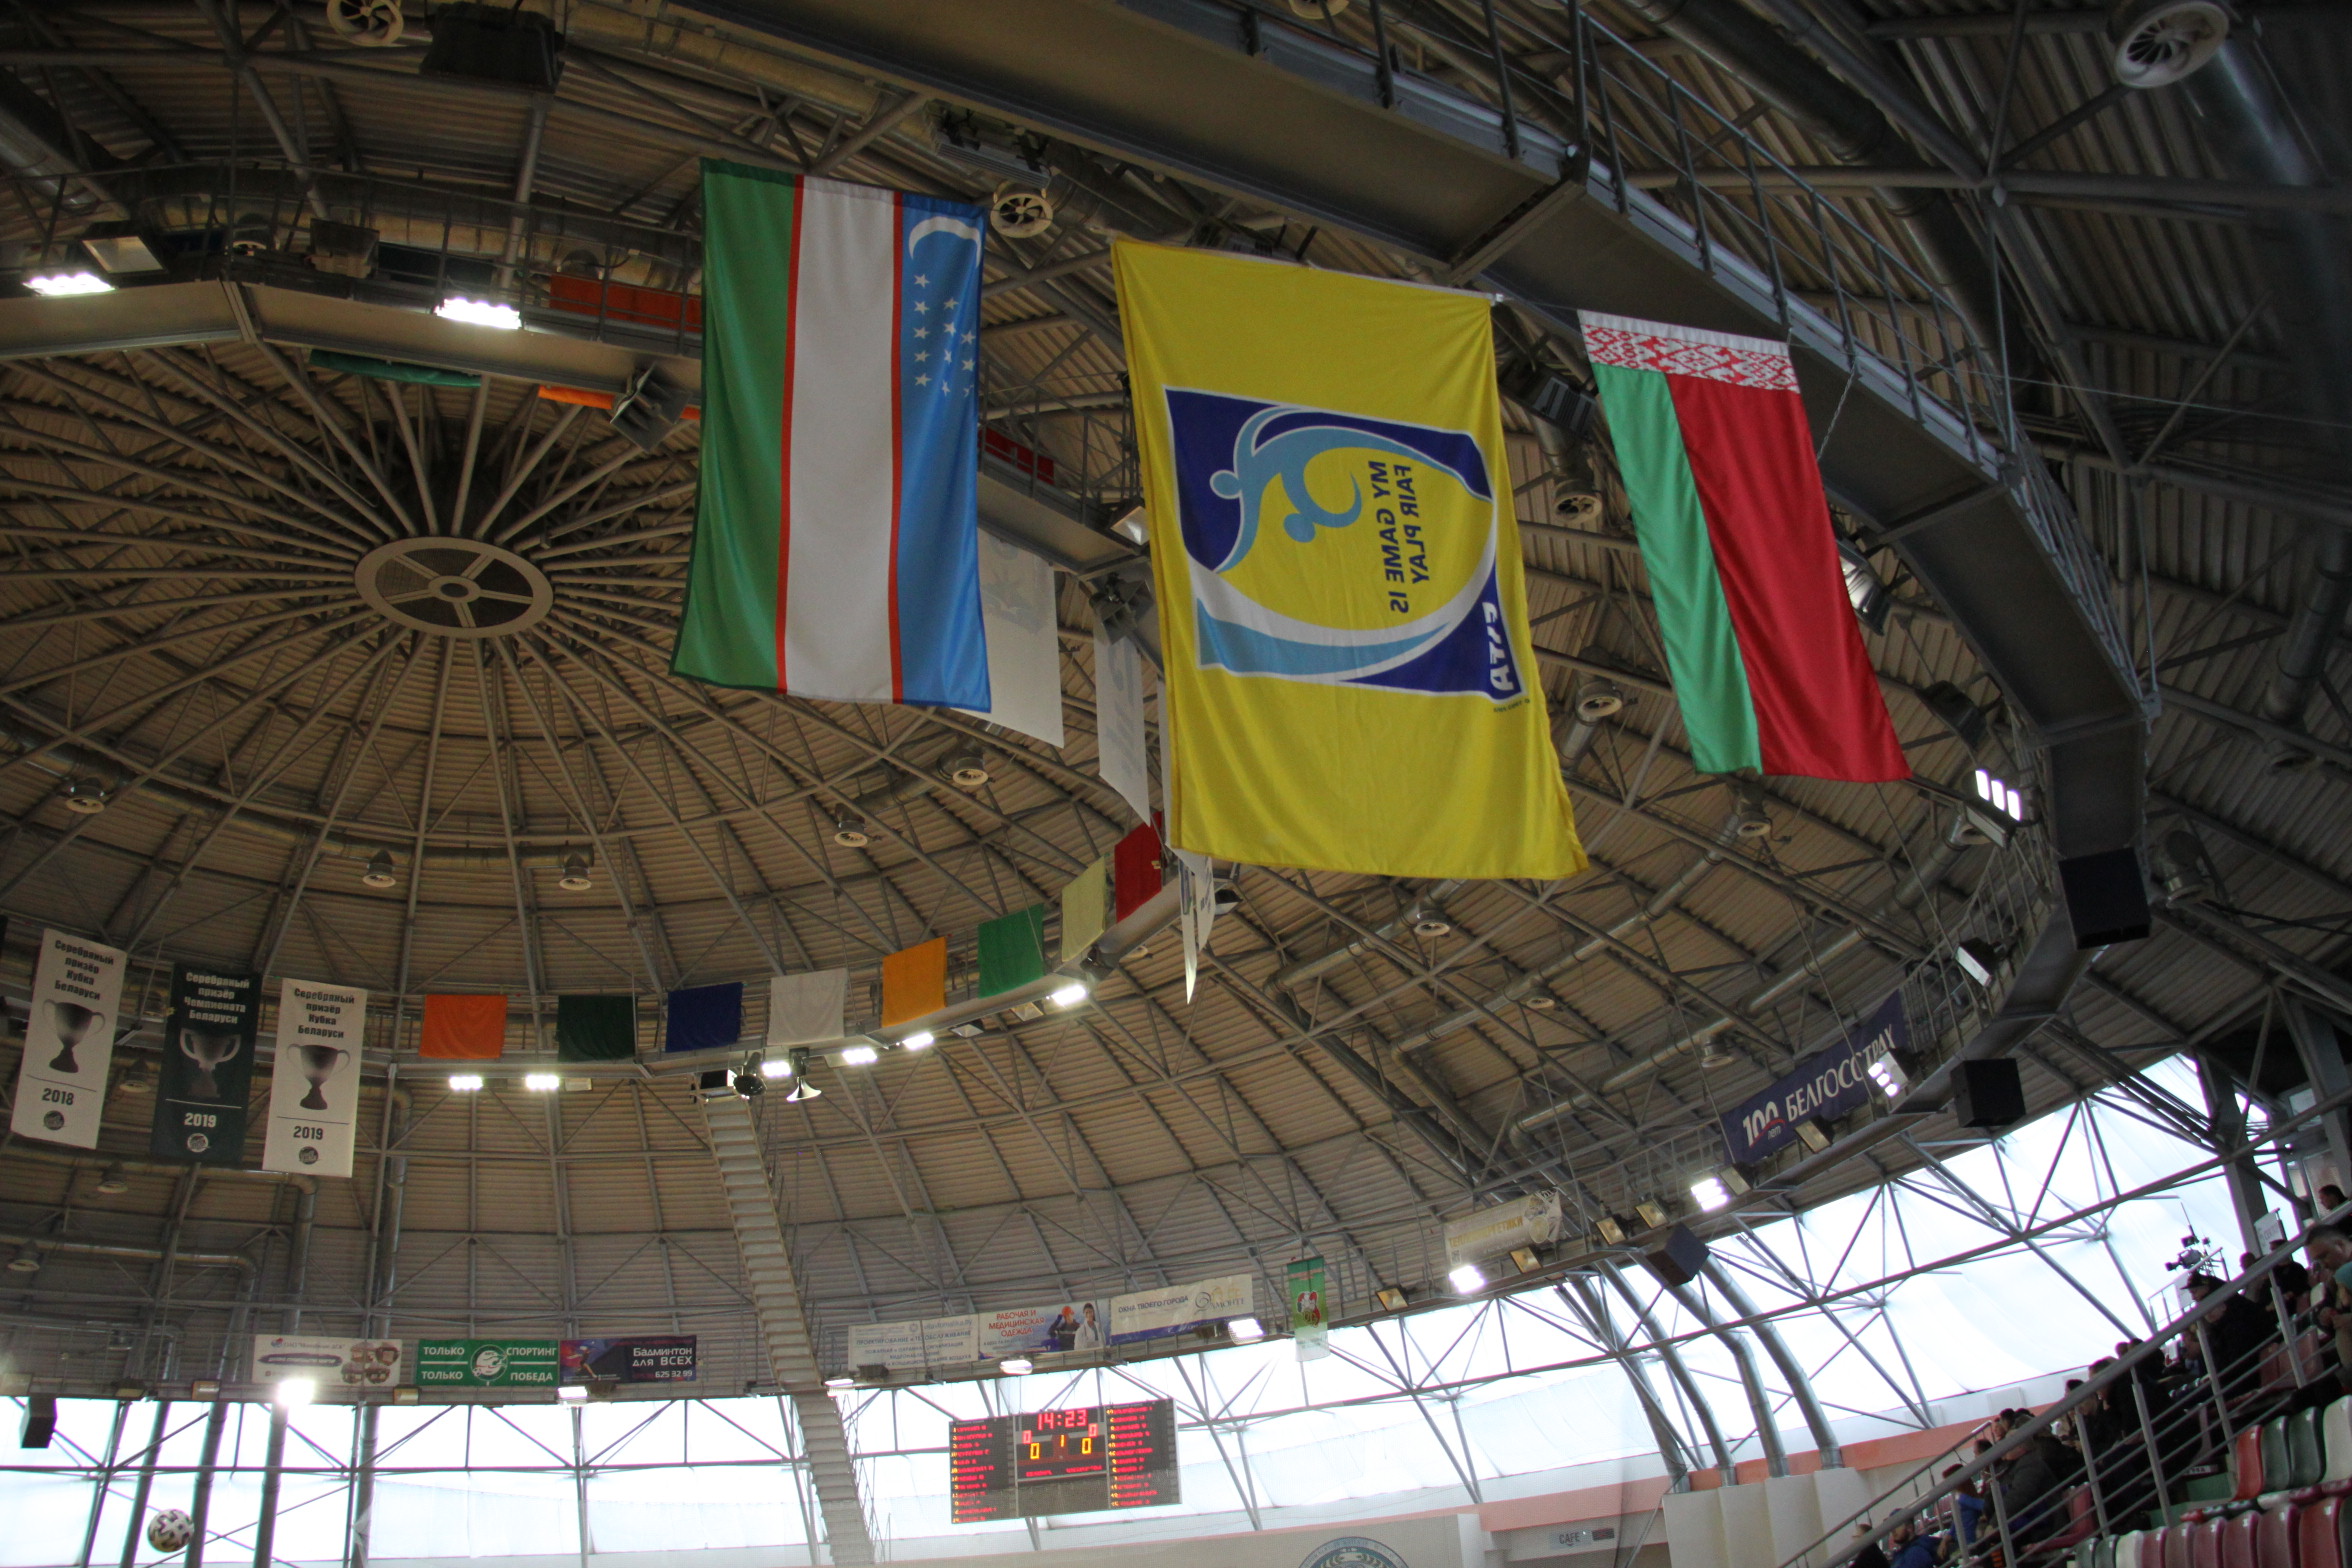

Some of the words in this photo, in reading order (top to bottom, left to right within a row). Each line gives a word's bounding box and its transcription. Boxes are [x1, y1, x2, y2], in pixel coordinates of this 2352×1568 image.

[54, 939, 114, 965] Серебряный
[65, 957, 99, 974] призёр
[66, 970, 95, 985] Кубка
[186, 972, 250, 989] Серебряный
[55, 980, 100, 1000] Беларуси
[198, 987, 235, 999] призёр
[294, 988, 355, 1004] Серебряный
[184, 996, 246, 1013] Чемпионата
[306, 1003, 341, 1014] призёр
[189, 1009, 238, 1024] Беларуси
[308, 1014, 337, 1025] Кубка
[298, 1025, 344, 1038] Беларуси
[1742, 1101, 1779, 1147] 100
[1785, 1024, 1894, 1122] БЕЛГОССТРАХ
[41, 1087, 75, 1106] 2018
[183, 1112, 217, 1128] 2019
[293, 1125, 324, 1141] 2019
[1137, 1301, 1162, 1309] ТВОЕГО
[1163, 1295, 1189, 1305] ГОРОДА
[988, 1317, 1046, 1329] МЕДИЦИНСКАЯ
[996, 1311, 1028, 1320] РАБОЧАЯ
[1001, 1328, 1033, 1338] ОДЕЖДА
[856, 1337, 909, 1345] ПРОЕКТИРОВАНИЕ
[423, 1347, 465, 1355] ТОЛЬКО
[506, 1347, 557, 1356] СПОРТИНГ
[632, 1359, 654, 1367] для
[660, 1356, 693, 1366] ВСЕХ
[421, 1371, 464, 1380] ТОЛЬКО
[510, 1372, 553, 1382] ПОБЕДА
[1038, 1409, 1088, 1431] 14:23
[1022, 1430, 1032, 1444] 0
[1088, 1423, 1098, 1438] 0
[1030, 1443, 1040, 1460] 0
[1082, 1437, 1092, 1454] 0
[1558, 1532, 1580, 1545] CAFE
